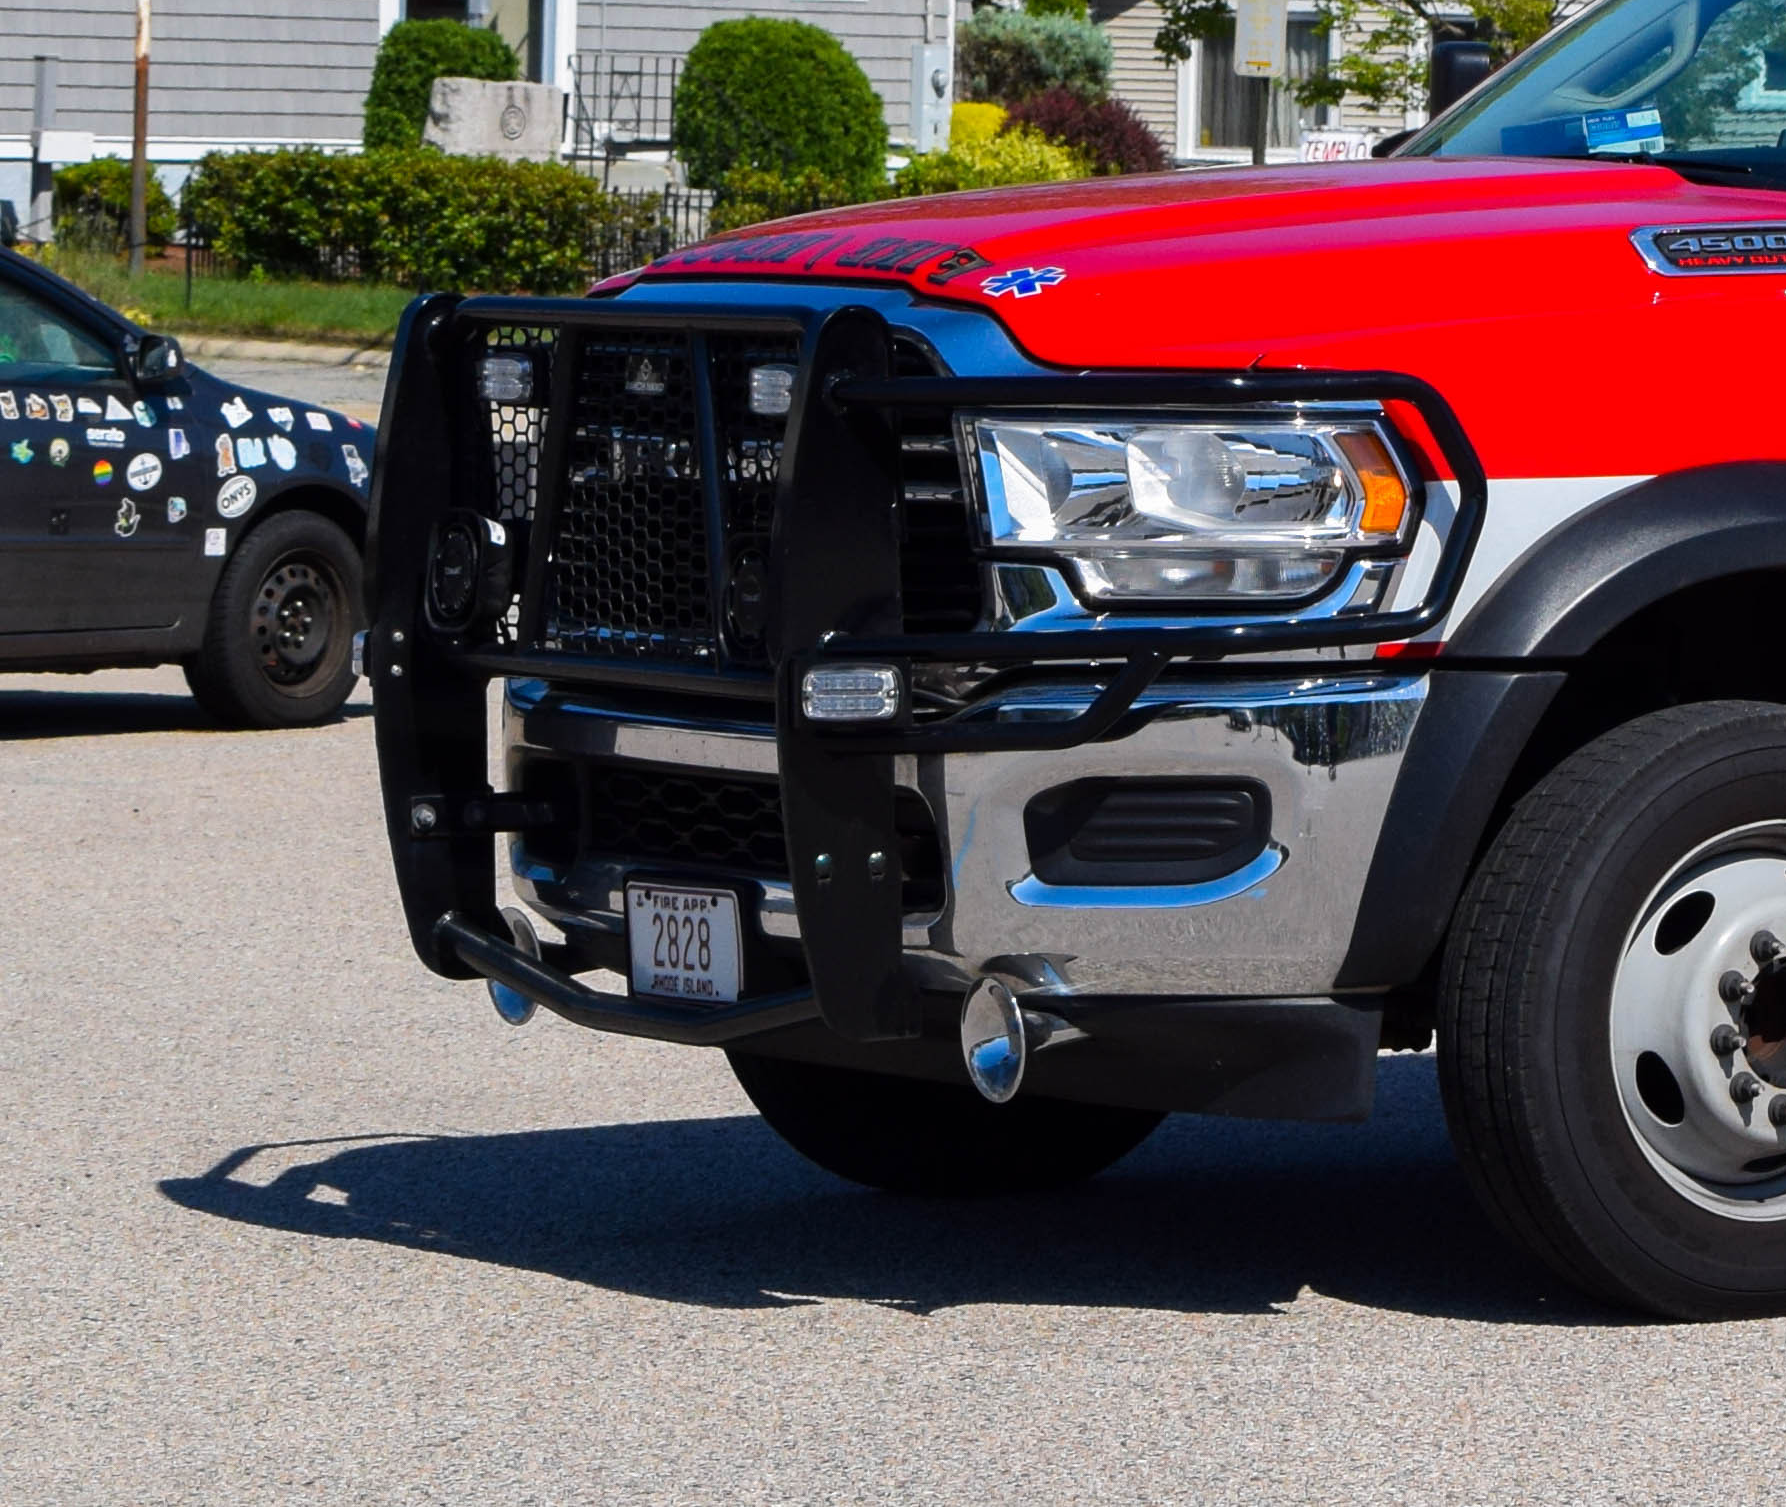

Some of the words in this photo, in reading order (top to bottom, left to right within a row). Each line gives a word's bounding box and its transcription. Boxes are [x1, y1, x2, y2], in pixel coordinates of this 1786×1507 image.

[1678, 256, 1744, 266] HEAVY
[653, 894, 679, 911] FIRE
[652, 913, 711, 971] 2828
